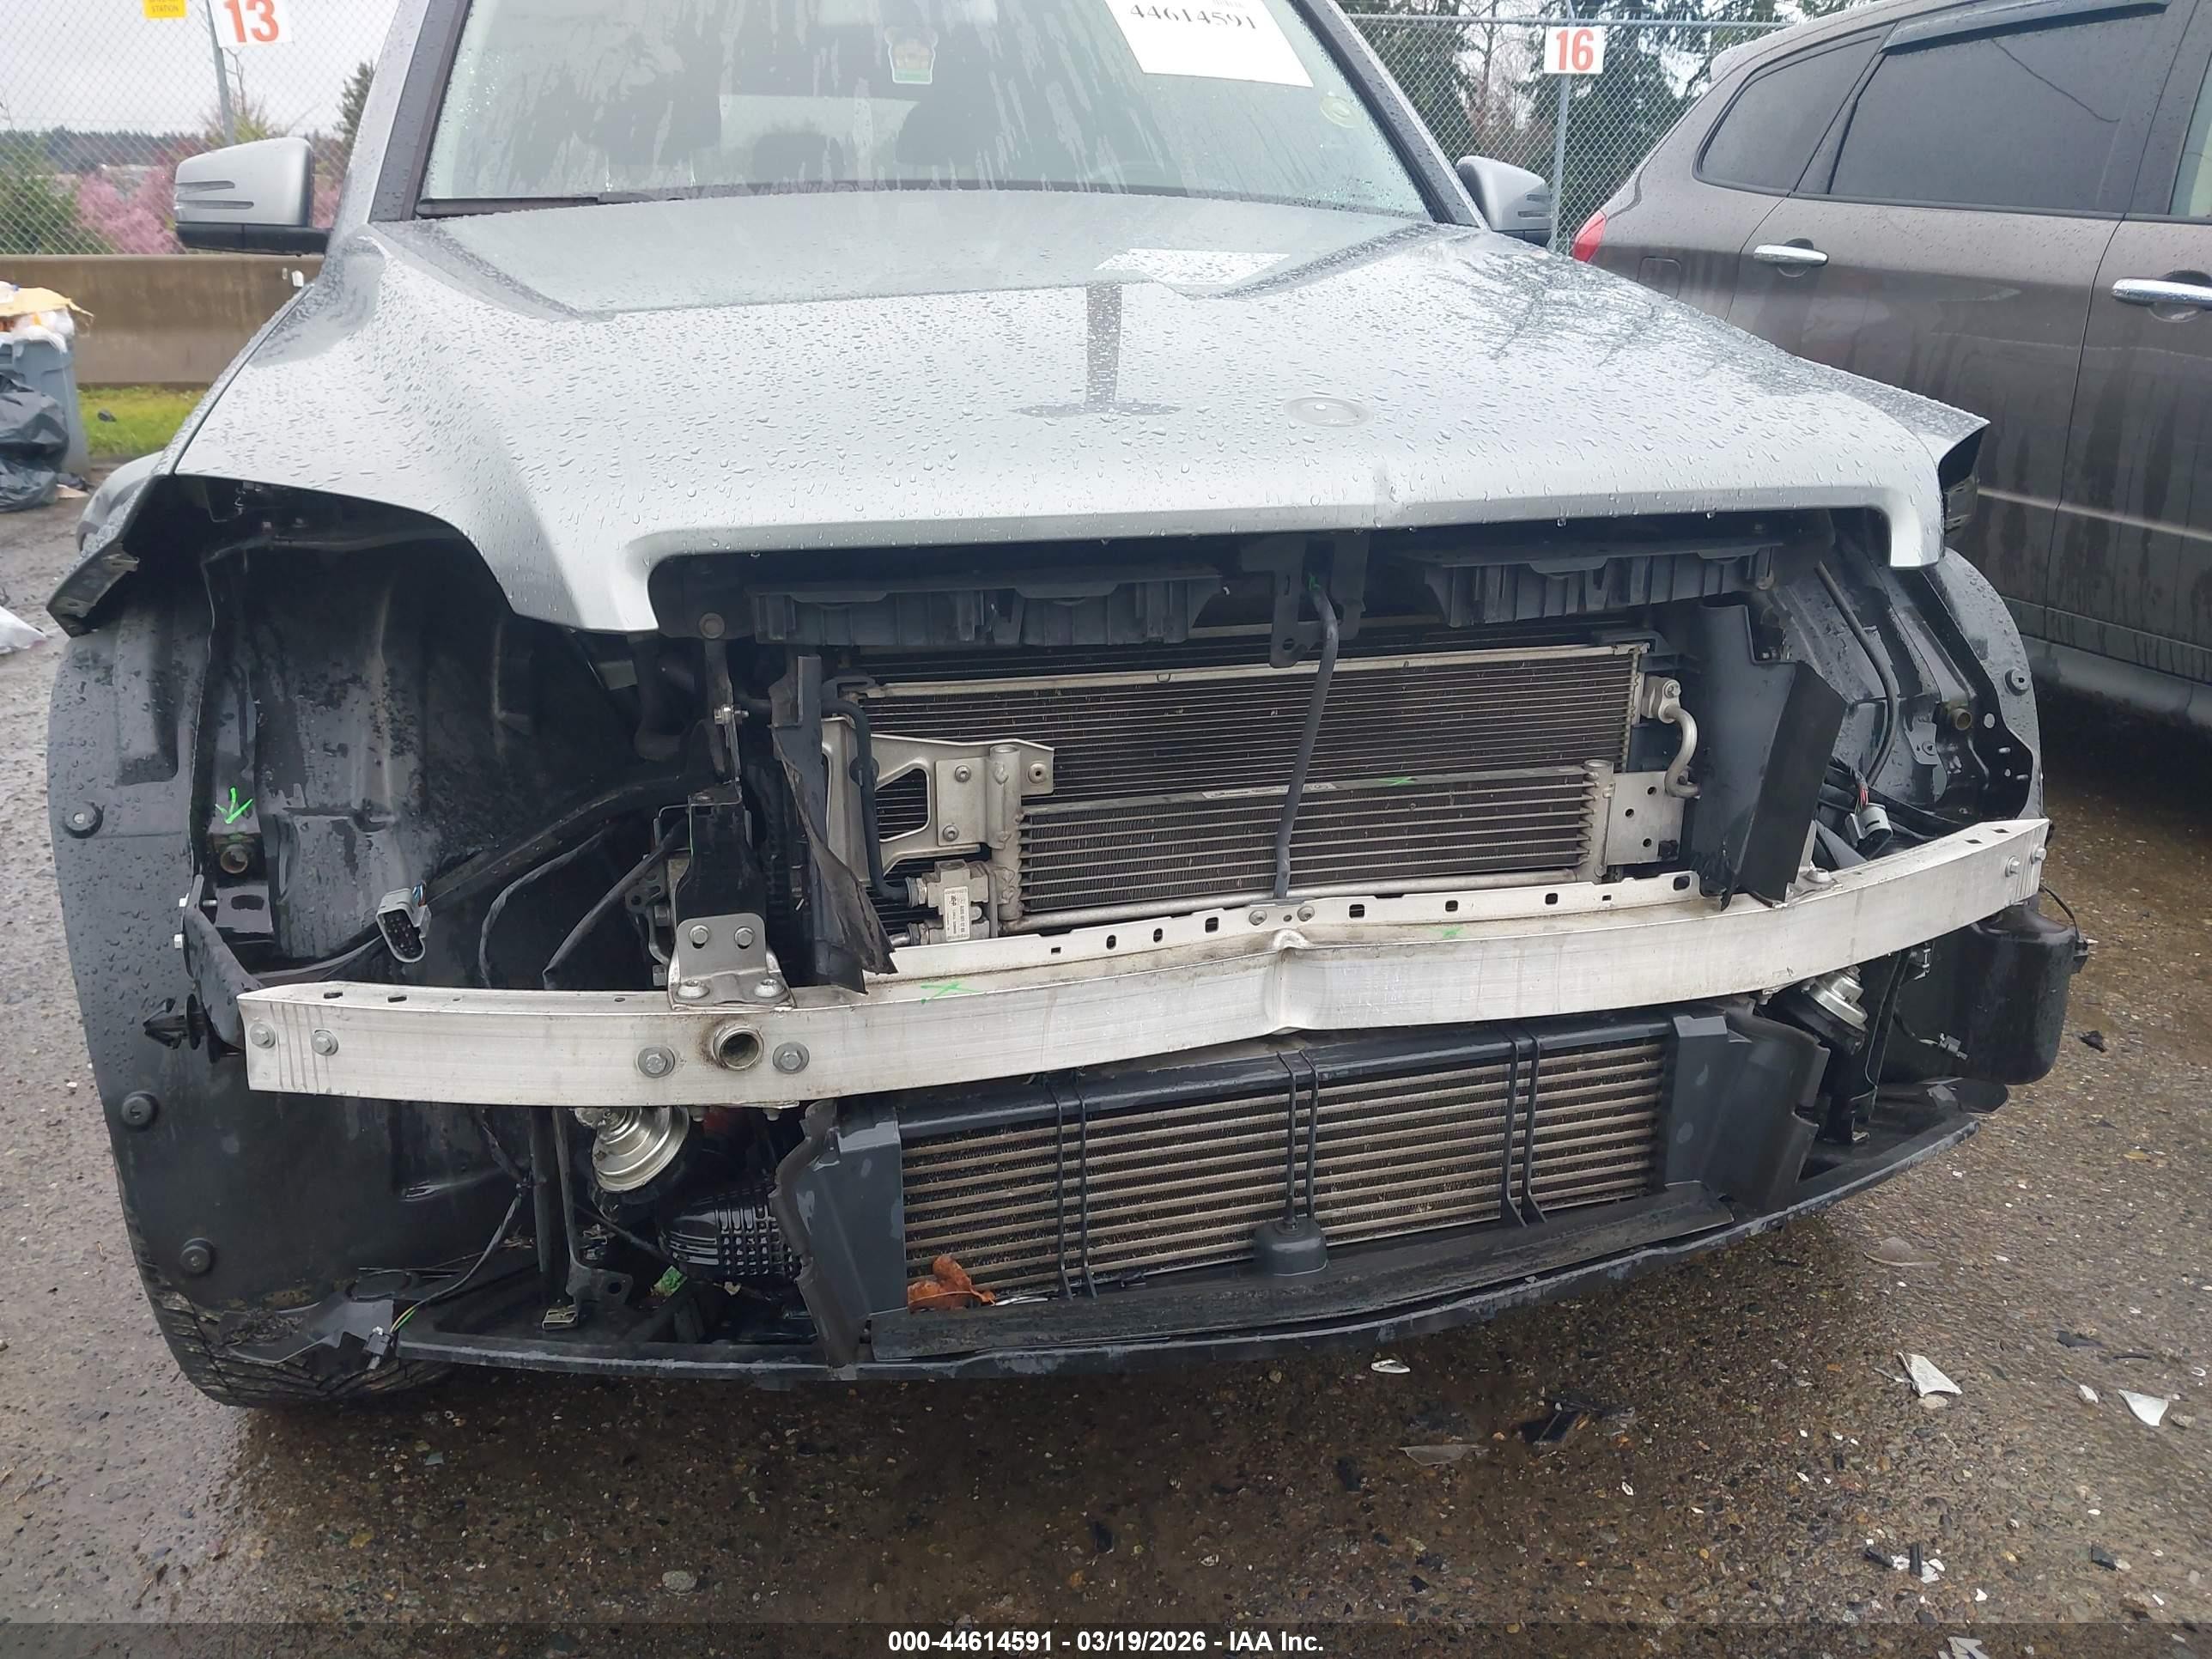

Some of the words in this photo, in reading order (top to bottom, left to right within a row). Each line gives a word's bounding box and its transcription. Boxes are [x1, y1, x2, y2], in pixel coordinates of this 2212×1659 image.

[224, 0, 279, 43] 13
[1130, 4, 1256, 29] 44614591
[1556, 28, 1595, 71] 16
